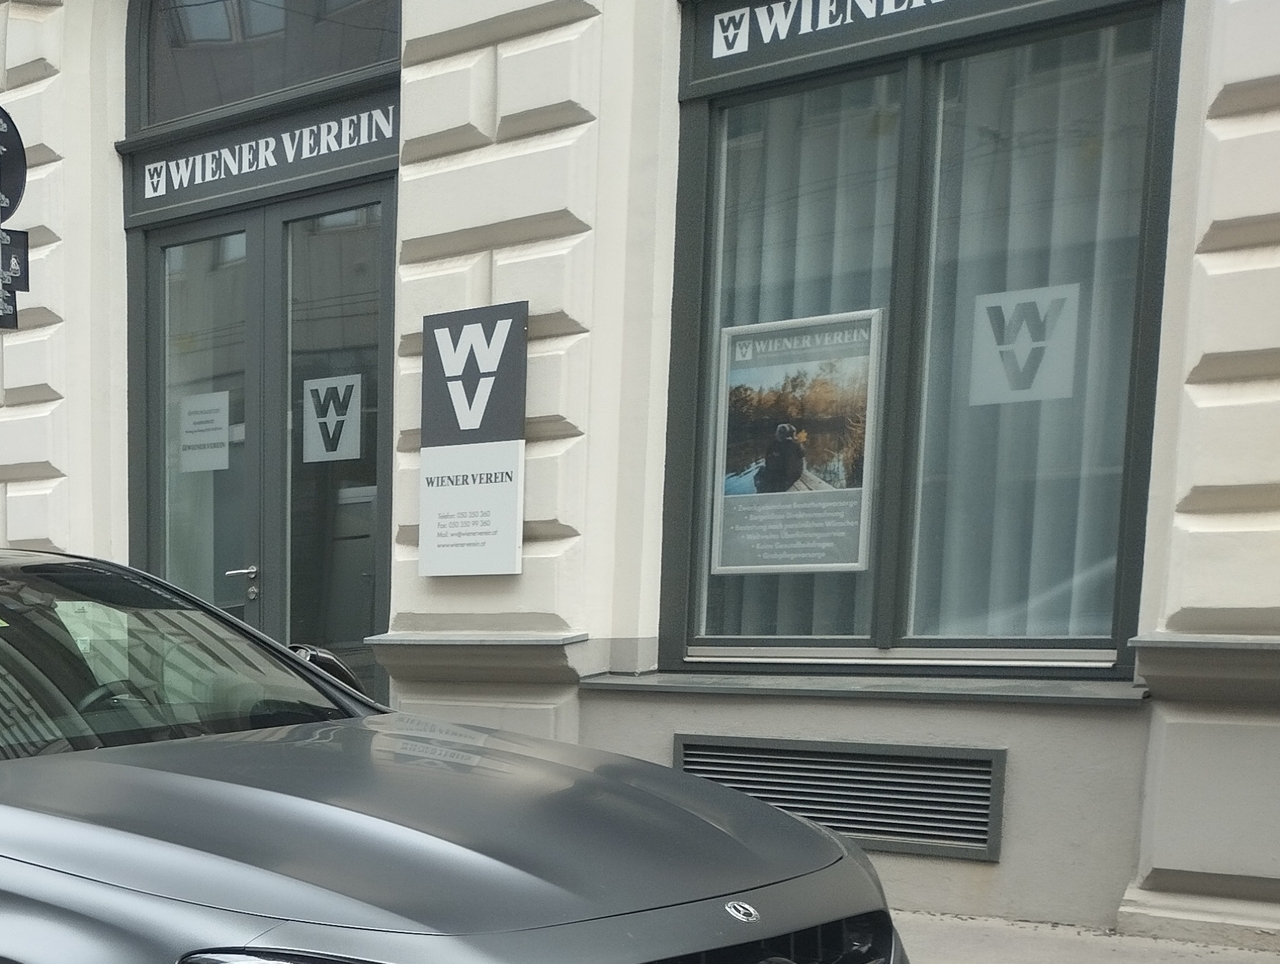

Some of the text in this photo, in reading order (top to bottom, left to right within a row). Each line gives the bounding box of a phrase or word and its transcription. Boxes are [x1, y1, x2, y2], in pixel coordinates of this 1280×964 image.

[168, 137, 277, 190] WIENER
[281, 105, 395, 163] VEREIN
[755, 335, 811, 352] WIENER
[815, 328, 869, 346] VEREIN
[425, 471, 513, 487] WIENER VEREIN
